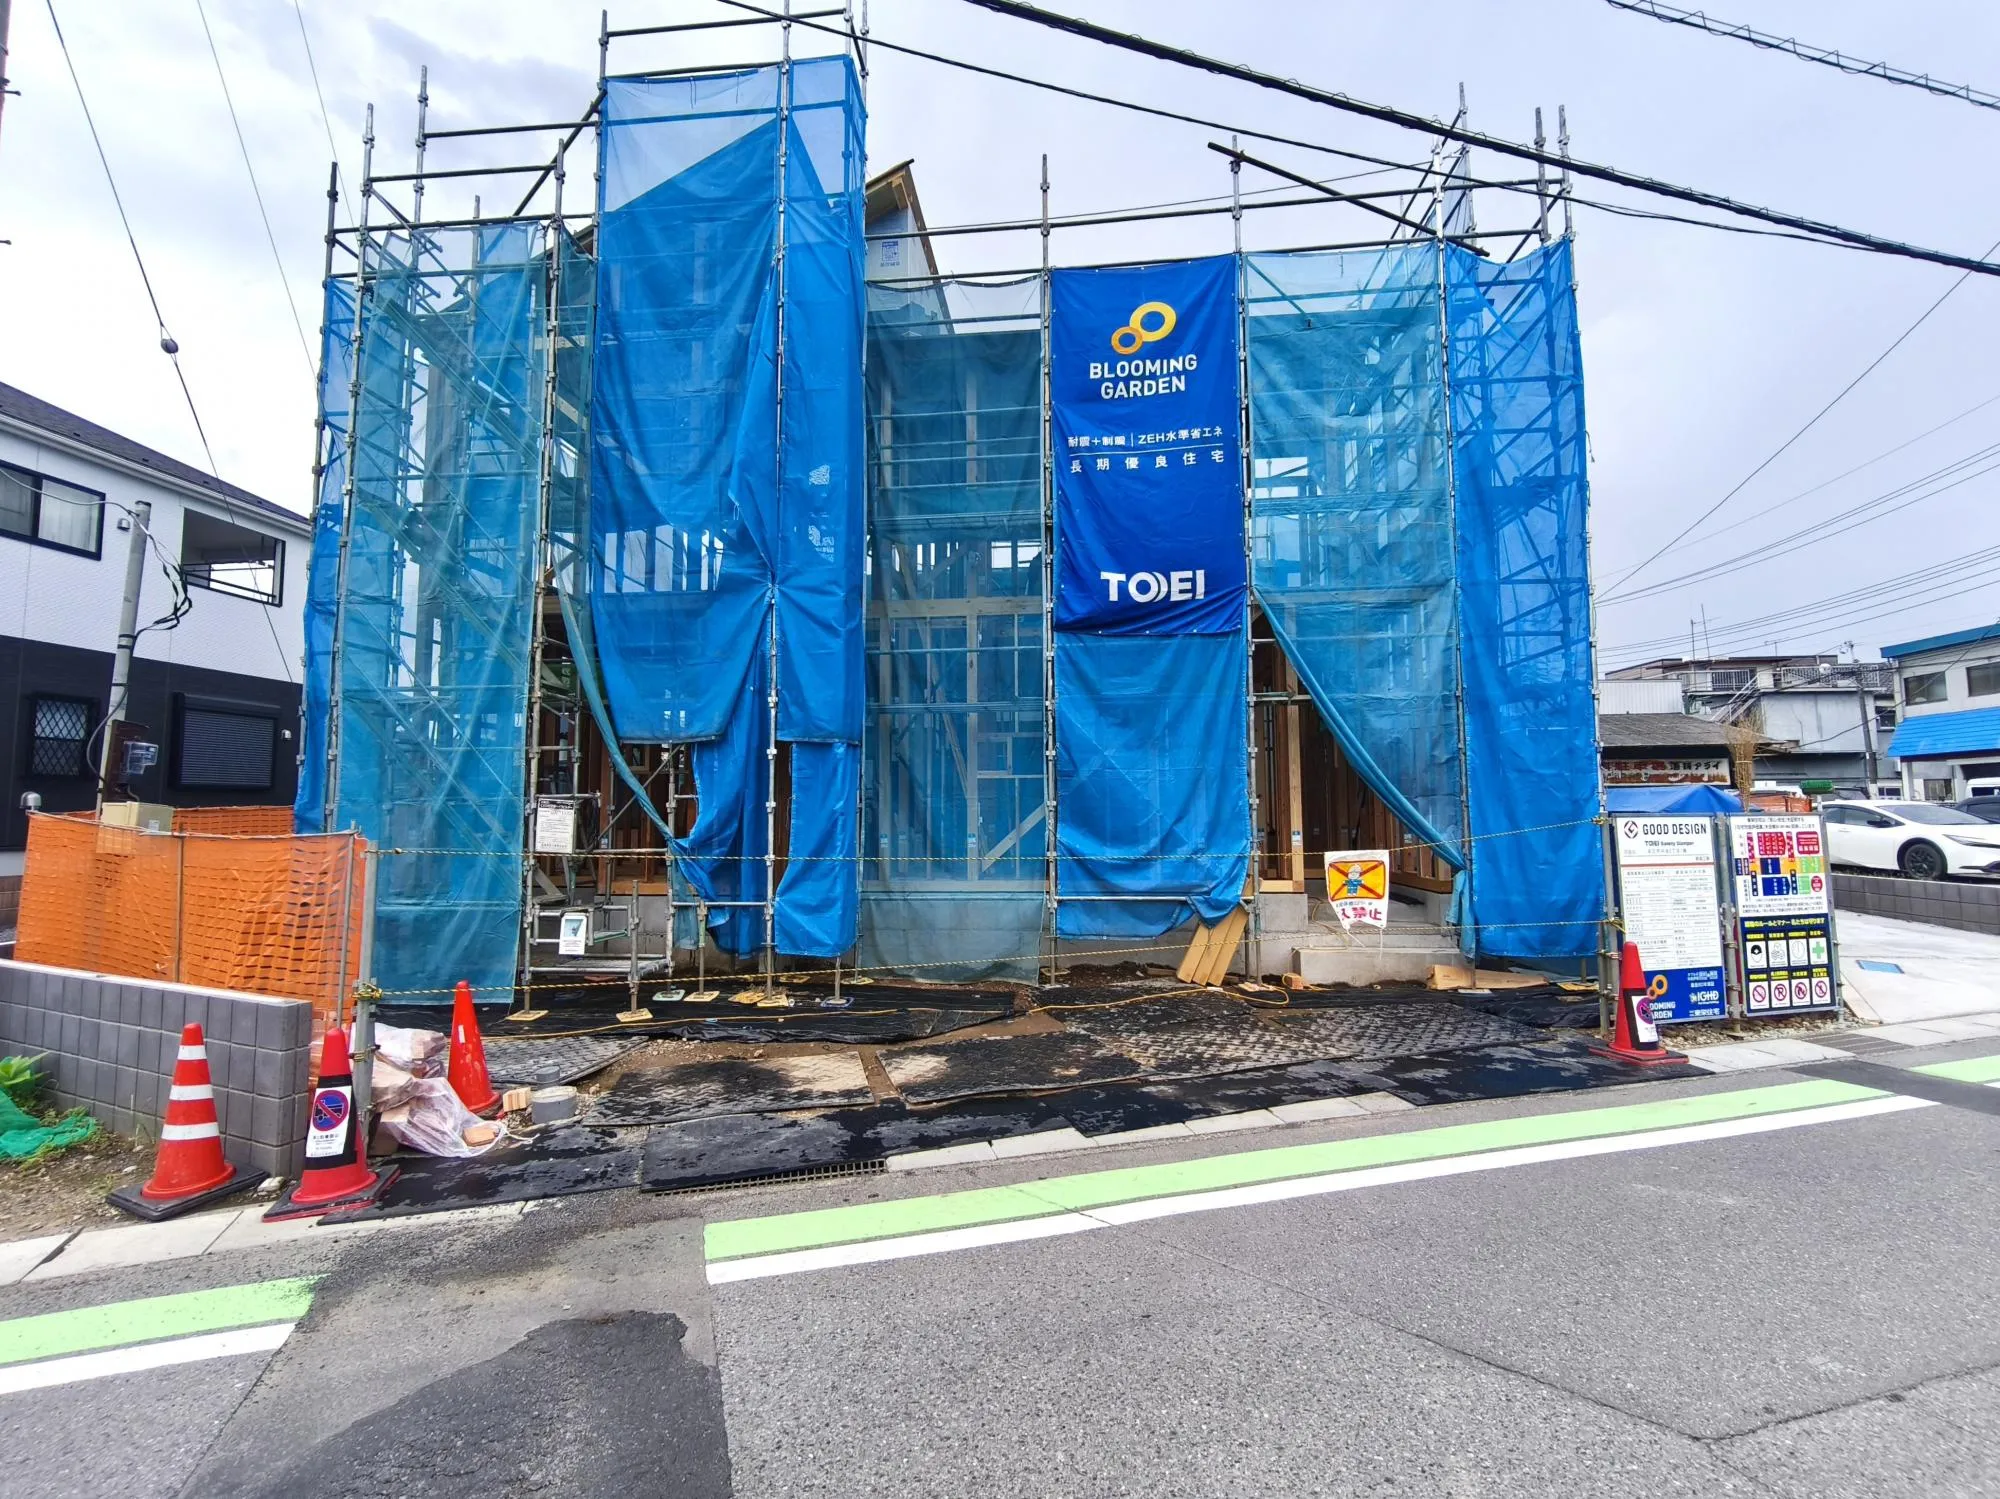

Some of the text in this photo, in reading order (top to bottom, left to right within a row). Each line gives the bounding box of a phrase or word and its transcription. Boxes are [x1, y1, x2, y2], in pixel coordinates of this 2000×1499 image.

[1089, 354, 1197, 379] BLOOMING
[1101, 375, 1185, 399] GARDEN
[1100, 569, 1205, 603] TOEI
[1642, 823, 1707, 835] GOOD DESIGN
[1649, 1001, 1676, 1011] OOMING
[1651, 1010, 1673, 1020] ARDEN
